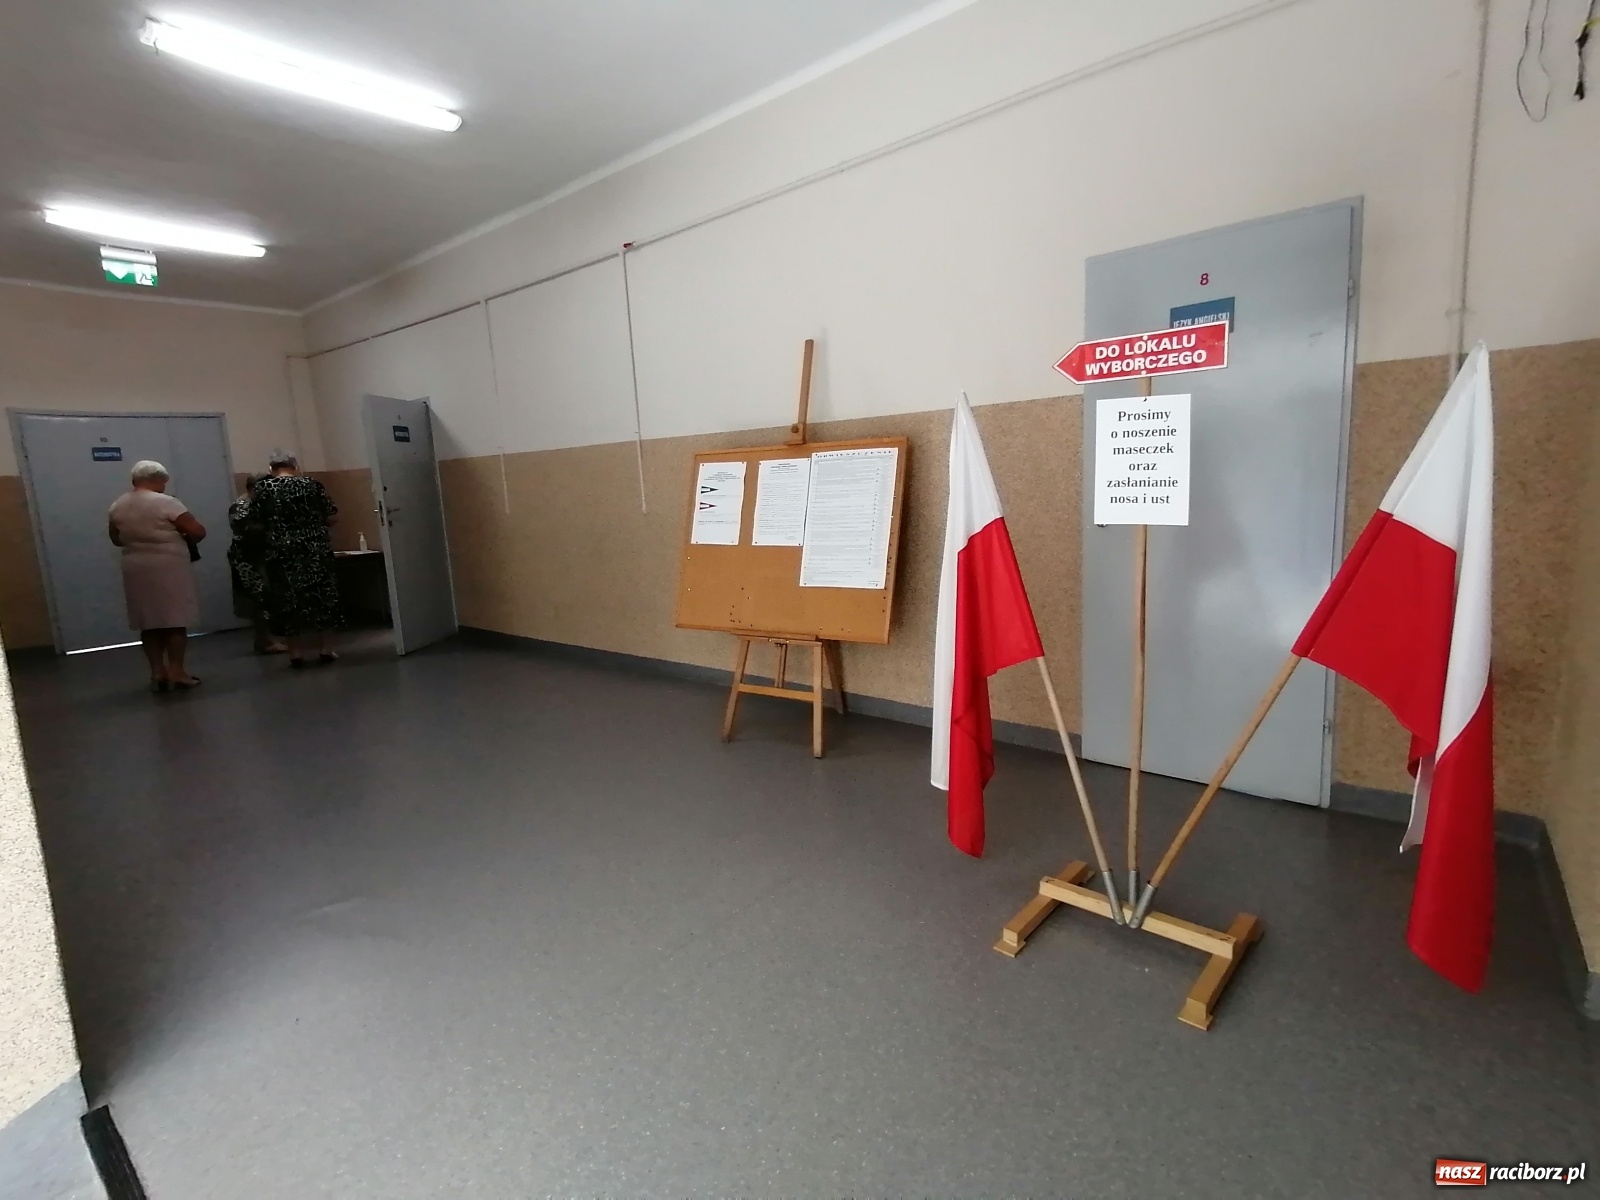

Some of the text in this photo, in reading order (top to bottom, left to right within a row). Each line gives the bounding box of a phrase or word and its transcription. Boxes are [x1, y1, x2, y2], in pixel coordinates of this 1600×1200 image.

[1200, 273, 1209, 286] 8
[1095, 333, 1197, 360] DO LOKALU
[1085, 349, 1207, 376] WYBORCZEGO
[1118, 408, 1171, 422] Prosimy
[1110, 425, 1177, 439] o noszenie
[1112, 442, 1174, 455] maseczek
[1128, 462, 1157, 471] oraz
[1106, 476, 1178, 488] zasłanianie
[1110, 493, 1171, 504] nosa i ust
